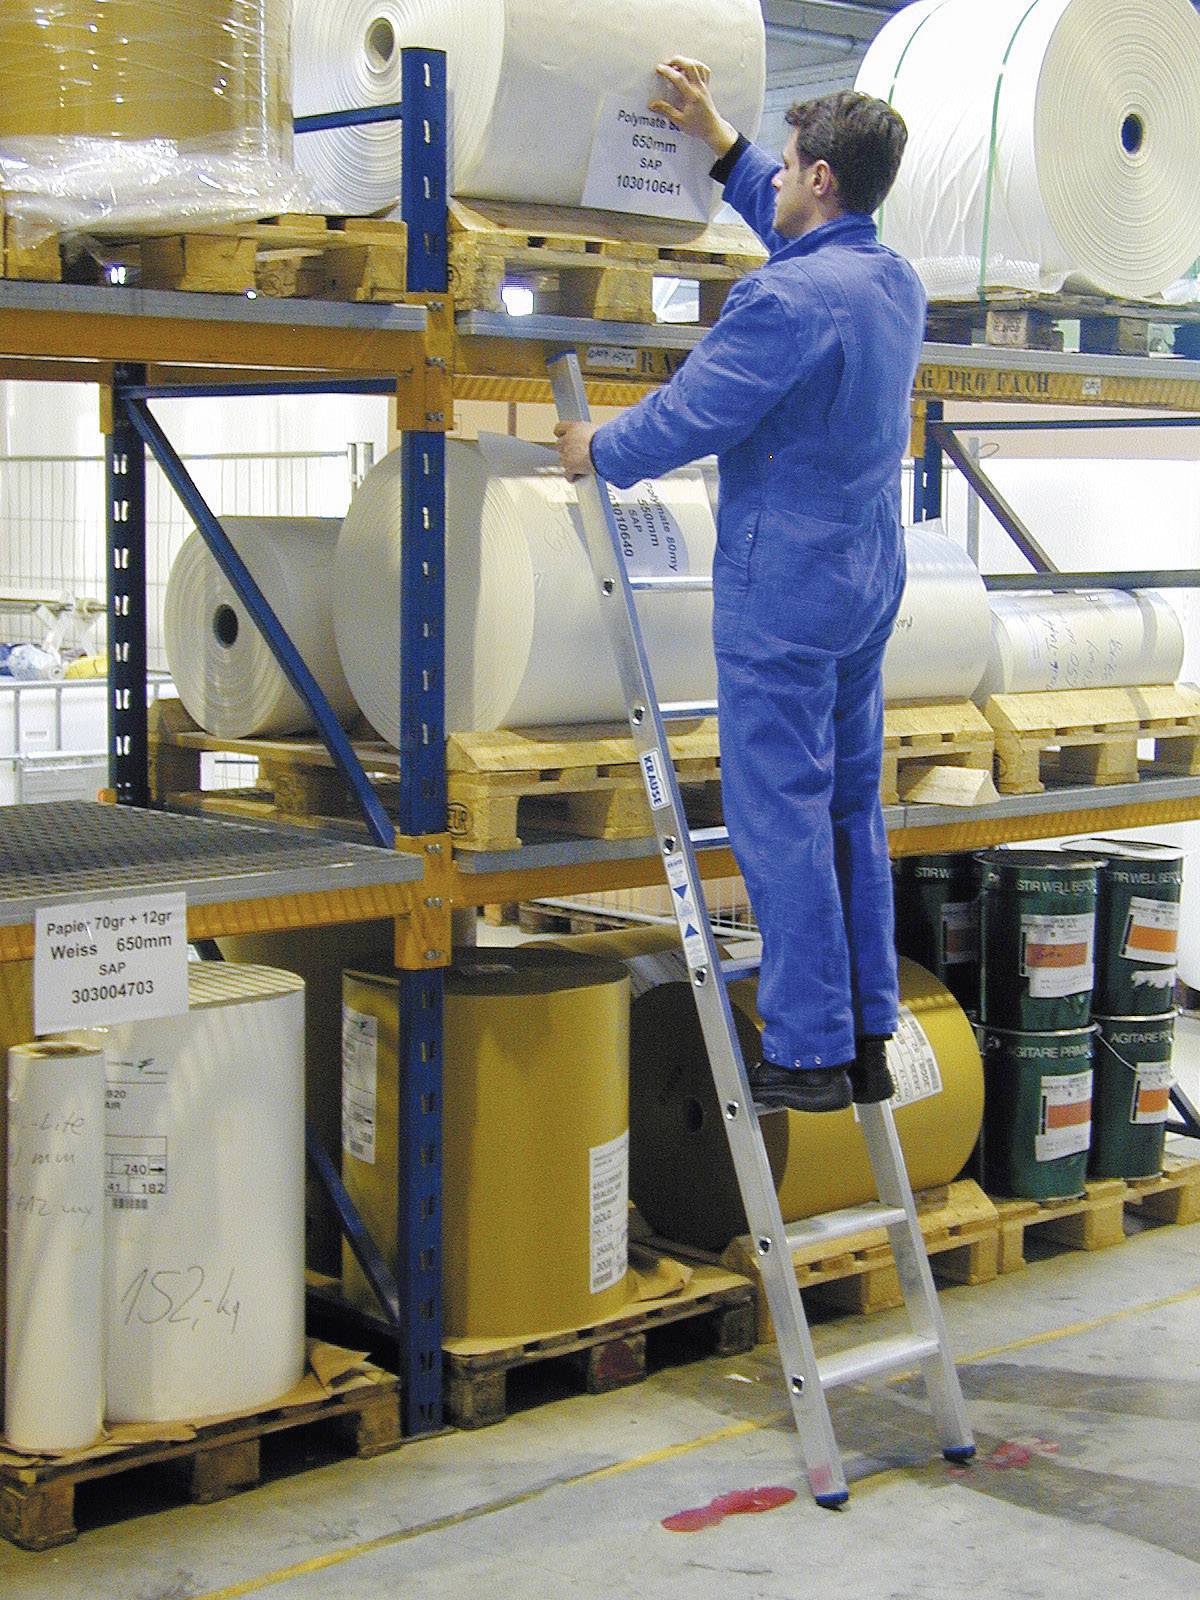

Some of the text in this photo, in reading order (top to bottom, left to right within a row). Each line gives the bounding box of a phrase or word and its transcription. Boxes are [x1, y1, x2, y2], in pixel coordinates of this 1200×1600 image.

[617, 109, 666, 130] Polymate
[631, 134, 677, 154] 650mm
[639, 157, 663, 171] SAP
[616, 174, 682, 196] 103010641
[948, 370, 987, 392] PRO
[996, 370, 1049, 393] FACH
[628, 508, 643, 533] SAP
[643, 755, 662, 806] KRAUSE
[914, 866, 938, 879] STIR
[1016, 879, 1041, 892] STIR
[1041, 880, 1071, 894] WELL
[46, 910, 173, 936] Papier 70gr + 12gr
[50, 934, 173, 961] Weiss 650mm
[98, 962, 127, 976] SAP
[71, 980, 155, 1004] 303004703
[1110, 1030, 1159, 1044] AGITARE
[1014, 1046, 1059, 1059] GITARE
[123, 1163, 148, 1176] 740
[141, 1182, 166, 1194] 182
